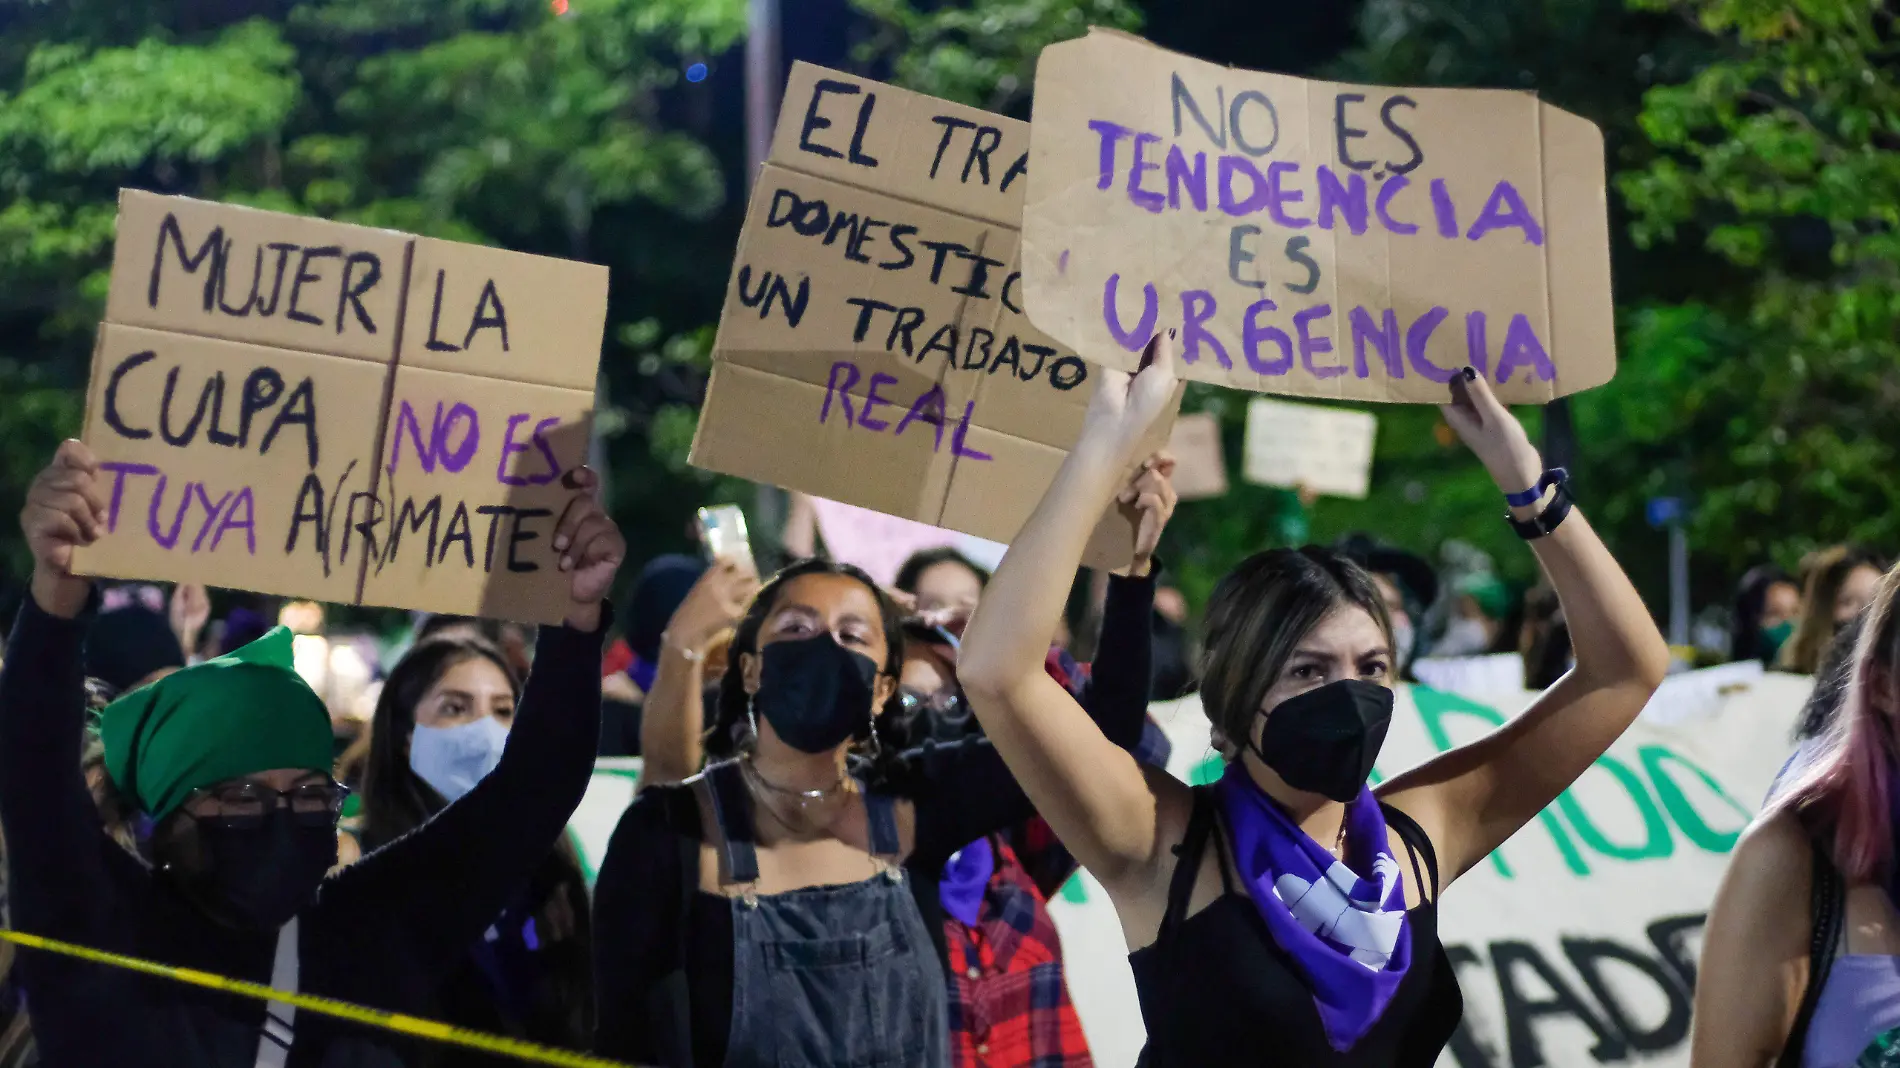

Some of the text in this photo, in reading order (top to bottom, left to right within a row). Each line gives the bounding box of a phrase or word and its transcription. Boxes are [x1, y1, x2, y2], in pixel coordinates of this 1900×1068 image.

[799, 79, 879, 168] EL
[1171, 71, 1424, 176] NO ES
[1087, 118, 1545, 247] TENDENCIA
[148, 212, 511, 353] MUJER LA
[1228, 223, 1322, 295] ES
[737, 263, 1088, 391] UN TRABAJO
[1103, 272, 1558, 384] URGENCIA
[104, 350, 563, 486] CULPA NO ES
[818, 360, 994, 461] REAL
[98, 461, 257, 556] TUYA
